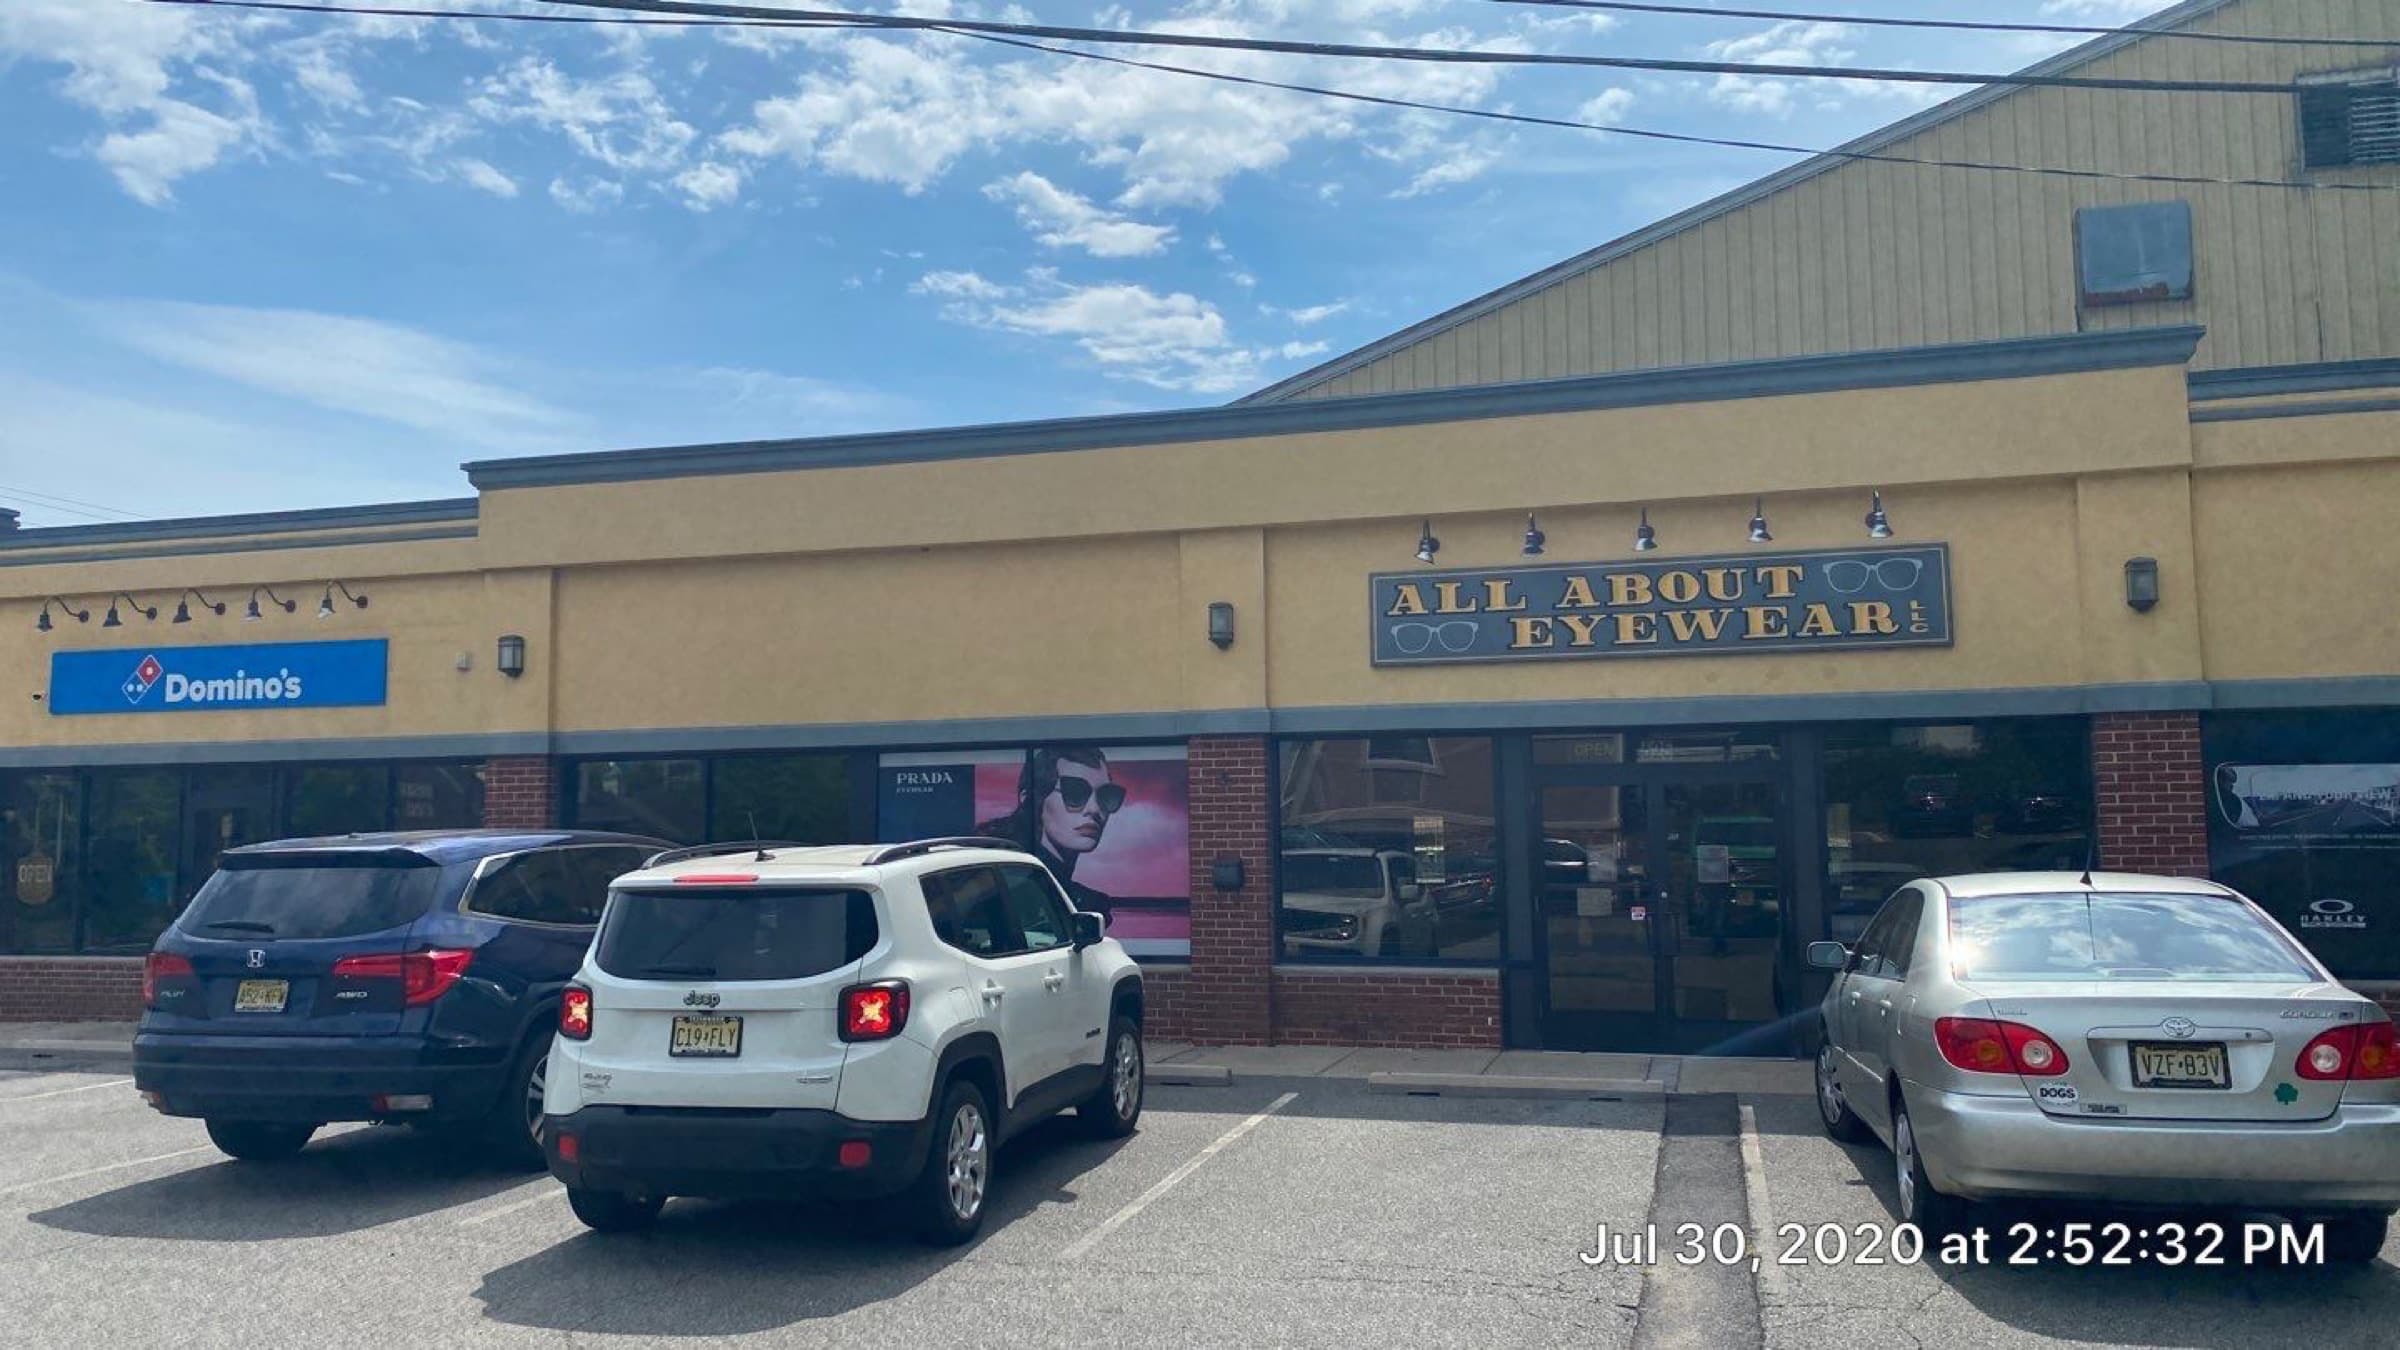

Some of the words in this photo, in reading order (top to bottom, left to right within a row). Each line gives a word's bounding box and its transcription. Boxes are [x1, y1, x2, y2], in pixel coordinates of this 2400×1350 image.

[1387, 580, 1527, 616] ALL
[1555, 565, 1803, 609] ABOUT
[1509, 601, 1900, 649] EYEWEAR
[1909, 599, 1929, 633] LLC
[165, 667, 302, 702] Domino's
[896, 771, 953, 785] PRADA
[2040, 1087, 2076, 1099] DOGS
